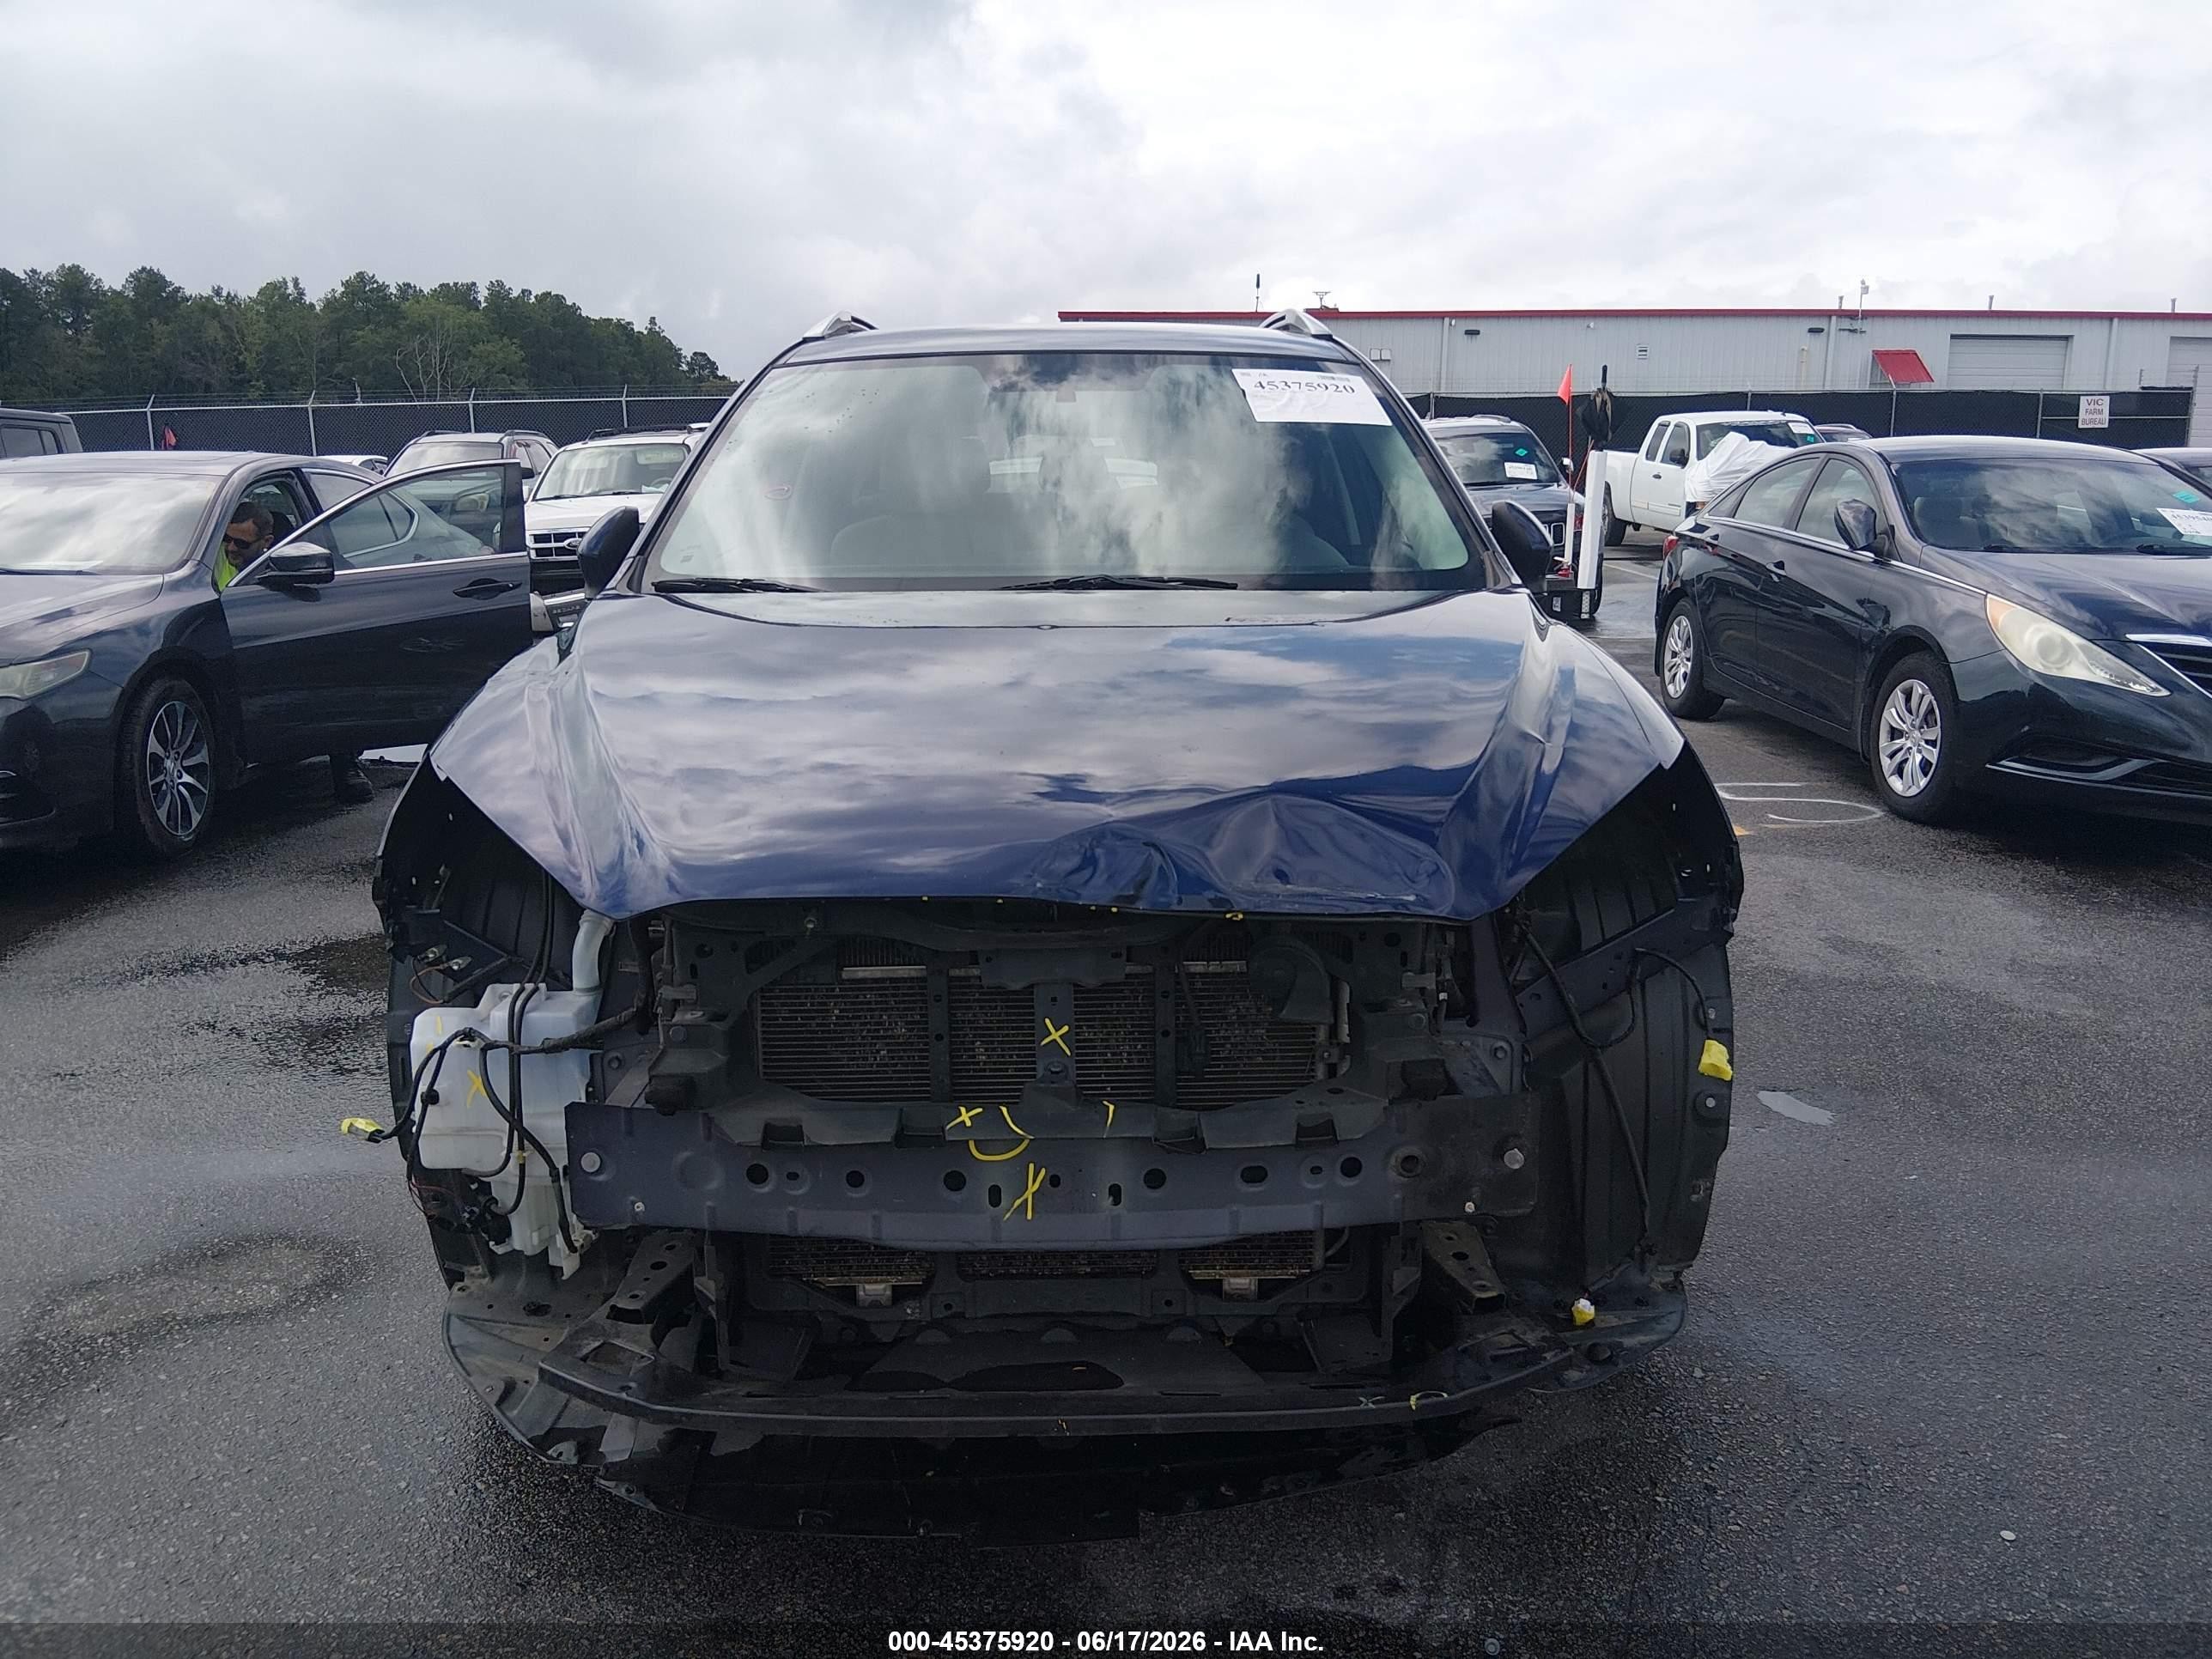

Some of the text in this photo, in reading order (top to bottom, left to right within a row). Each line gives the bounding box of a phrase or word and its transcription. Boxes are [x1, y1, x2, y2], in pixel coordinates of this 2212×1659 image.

[1254, 380, 1356, 394] 45375920
[2086, 398, 2104, 406] VIC
[2081, 417, 2106, 426] BUREAU
